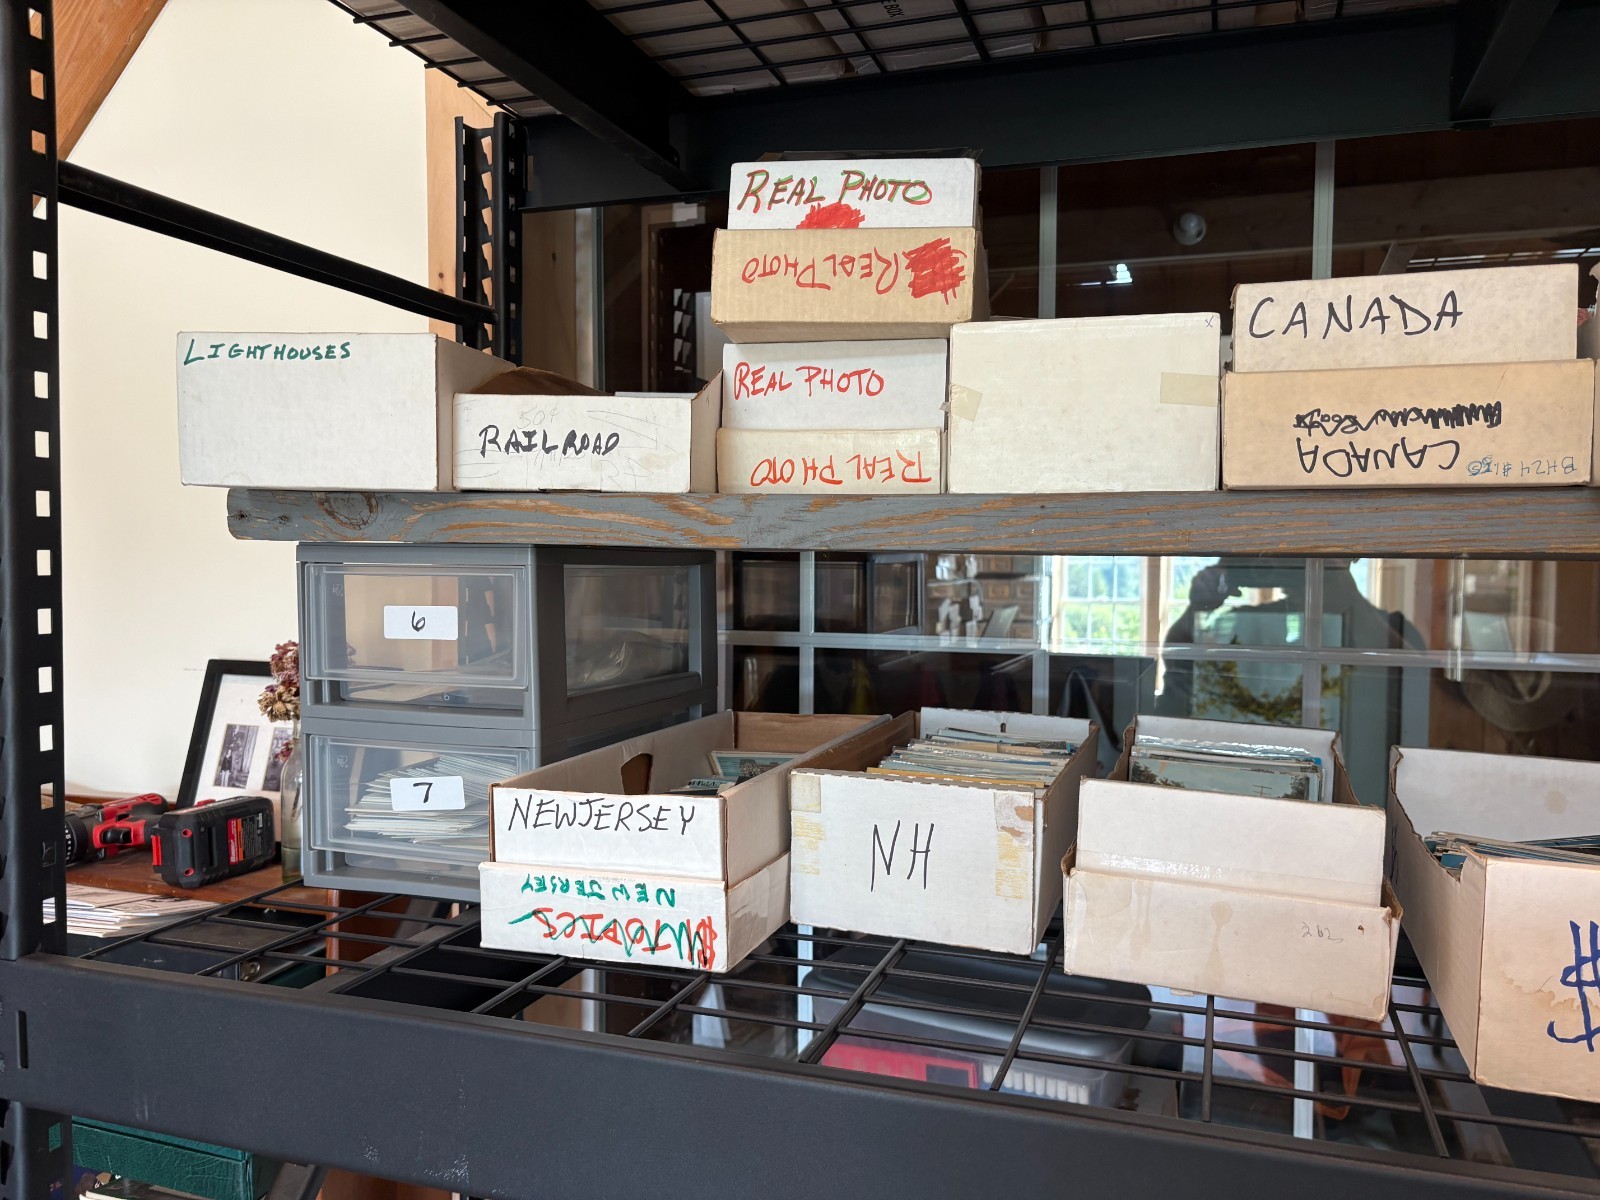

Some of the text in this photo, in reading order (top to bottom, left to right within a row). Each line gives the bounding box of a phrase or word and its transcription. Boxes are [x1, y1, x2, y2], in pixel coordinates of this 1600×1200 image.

[737, 169, 933, 214] REAL PHOTO
[741, 246, 899, 295] REAL PHOTO
[1250, 290, 1463, 340] CANADA
[183, 338, 352, 366] LIGHTHOUSES
[734, 361, 885, 401] REAL PHOTO
[479, 424, 620, 459] RAILROAD
[1296, 437, 1461, 478] CANADA
[750, 449, 933, 487] REAL PHOTO
[411, 610, 426, 632] 6
[413, 782, 433, 804] 7
[870, 820, 935, 892] NH
[520, 873, 676, 908] NEW JERSEY
